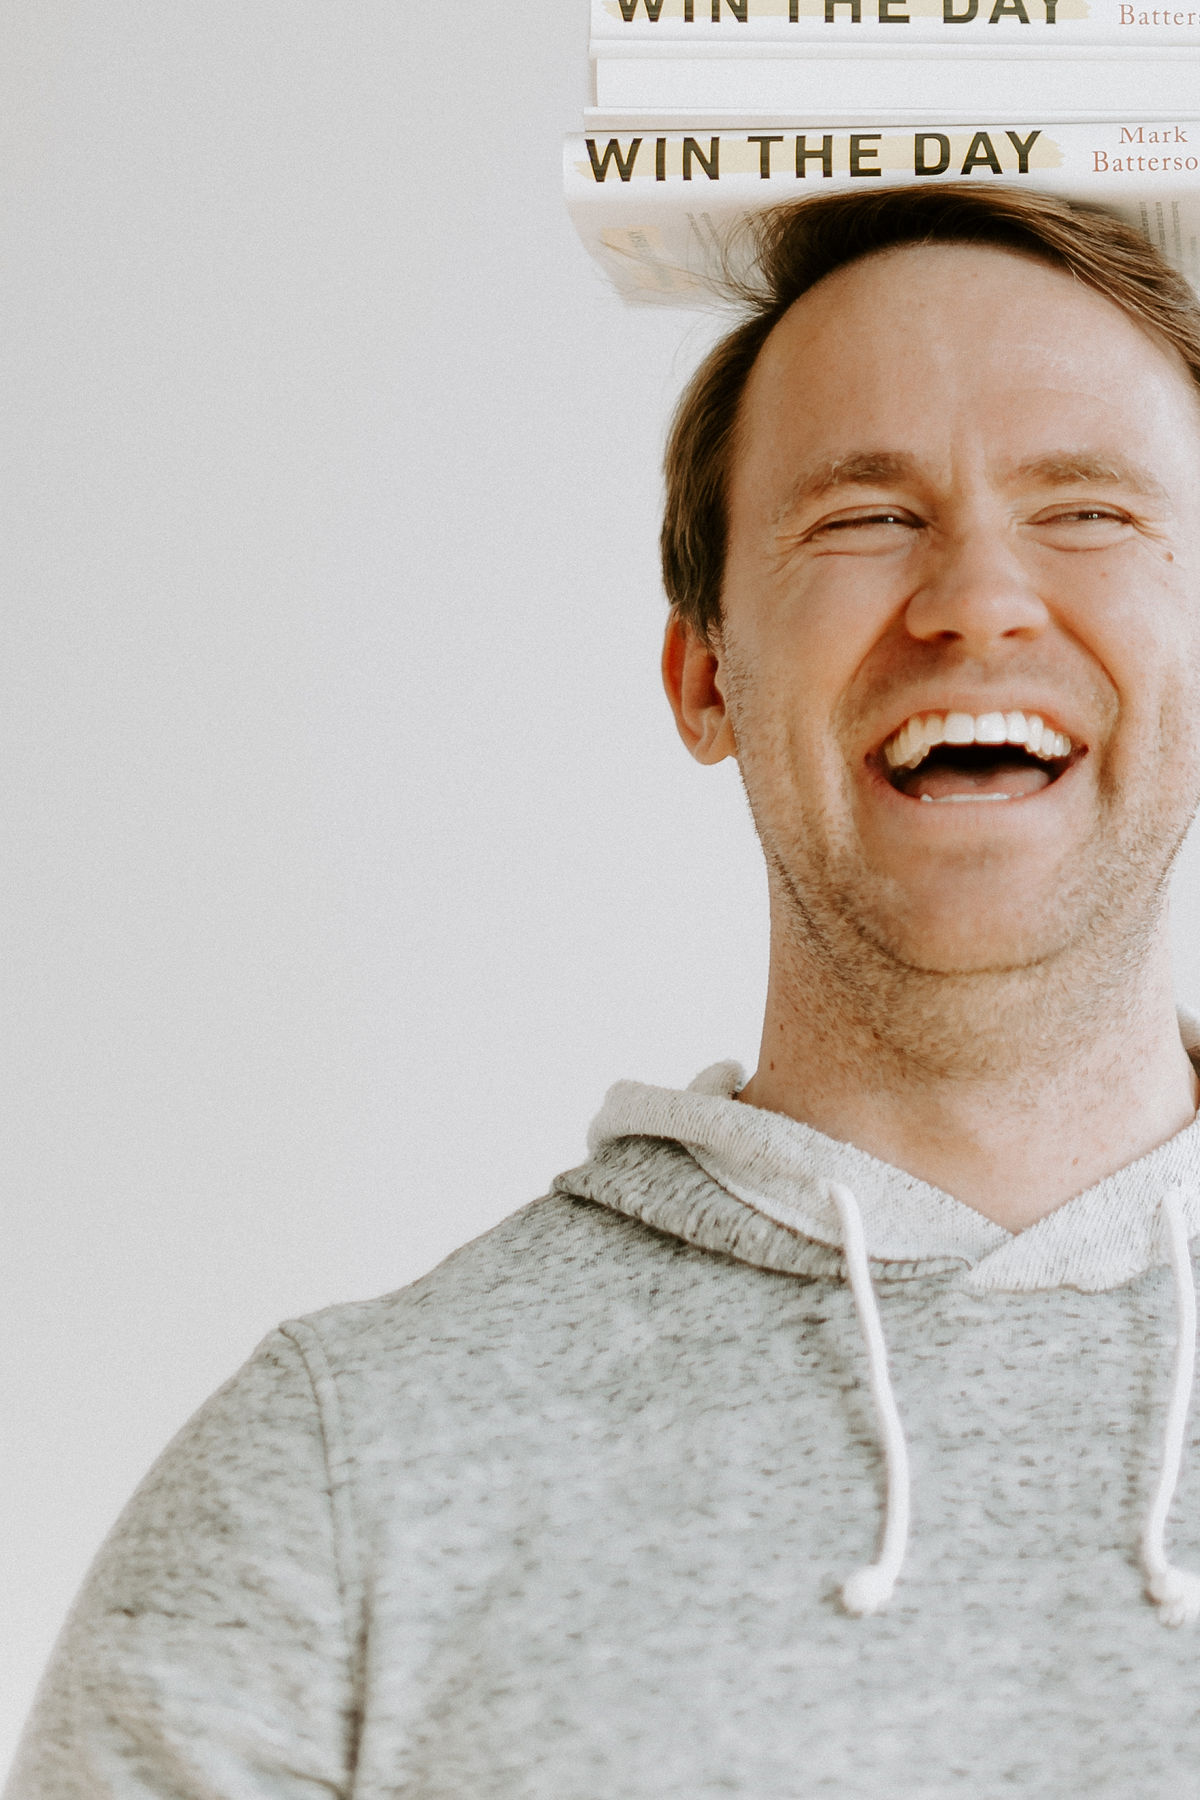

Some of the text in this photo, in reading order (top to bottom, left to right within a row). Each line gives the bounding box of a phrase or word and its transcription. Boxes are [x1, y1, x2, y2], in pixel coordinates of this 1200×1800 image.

[1119, 126, 1188, 144] Mark
[584, 131, 1042, 182] WIN THE DAY
